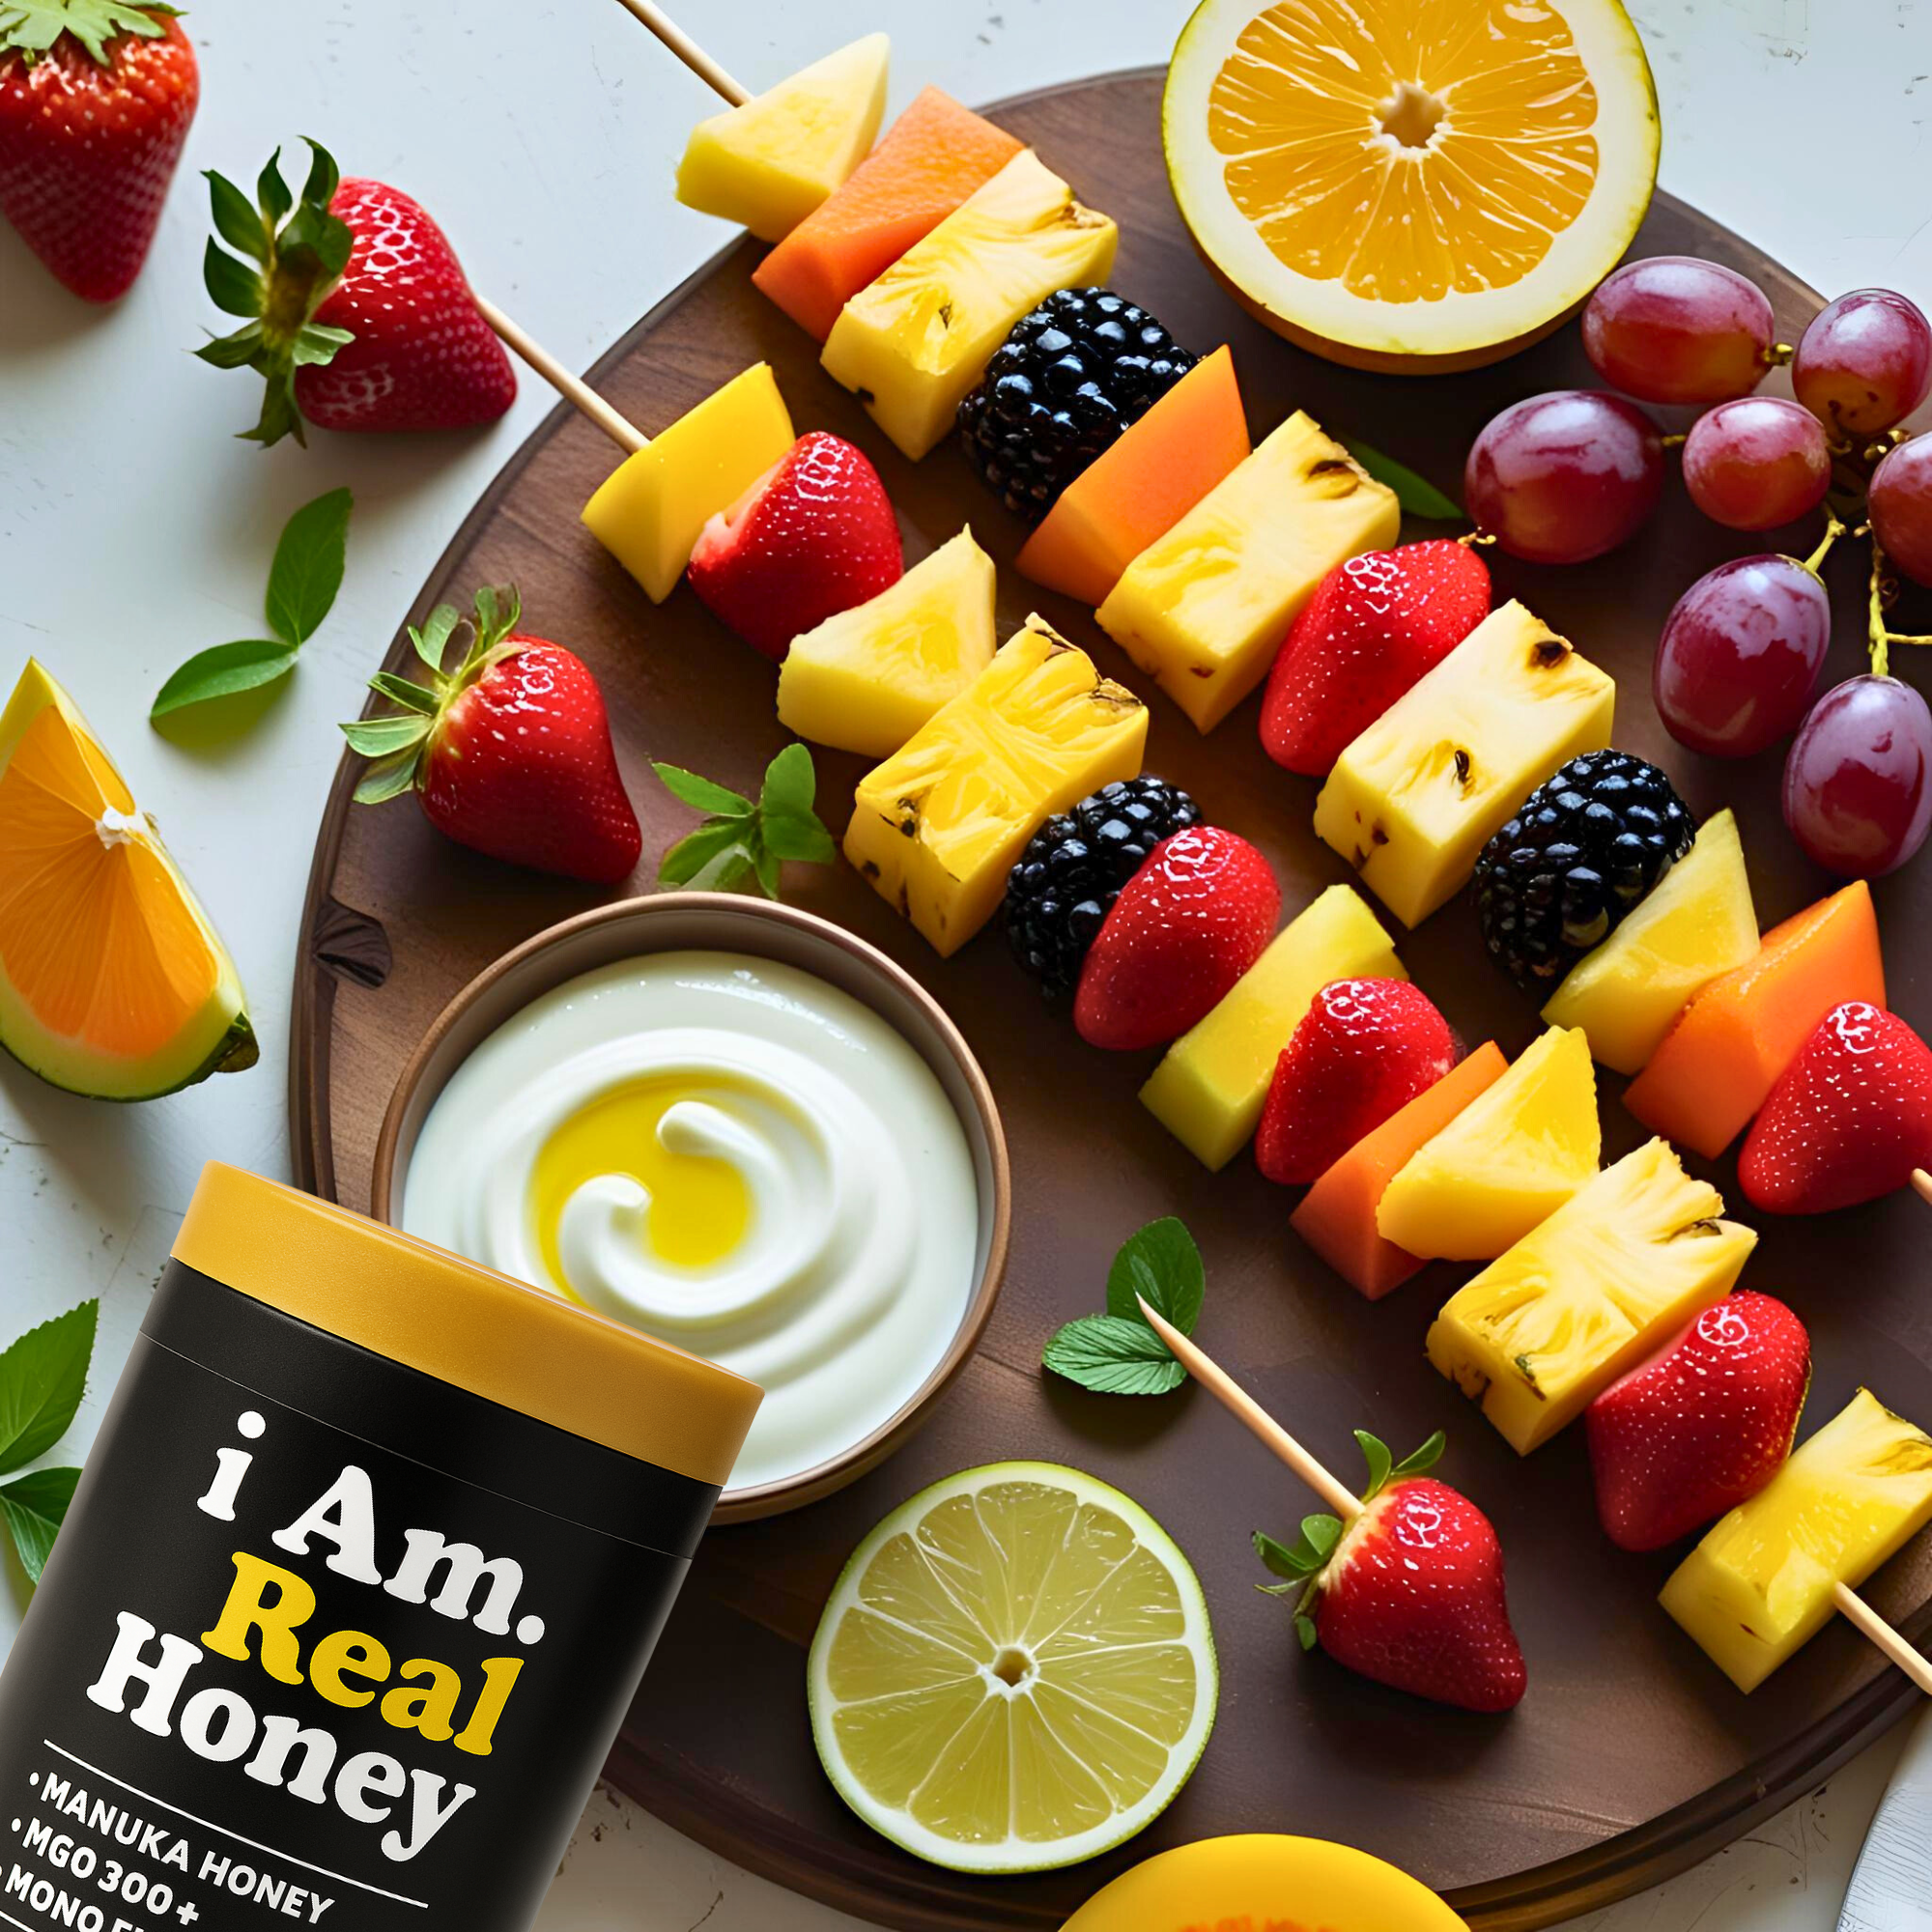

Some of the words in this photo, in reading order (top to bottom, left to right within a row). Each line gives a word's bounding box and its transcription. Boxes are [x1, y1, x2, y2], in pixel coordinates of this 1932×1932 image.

[197, 1410, 266, 1521] i
[271, 1464, 546, 1645] Am.
[87, 1610, 477, 1862] Honey
[201, 1551, 525, 1755] Real
[4, 1862, 104, 1932] MONO
[21, 1817, 98, 1879] MGO
[98, 1860, 200, 1926] 300+
[40, 1772, 189, 1873] MANUKA
[197, 1850, 336, 1924] HONEY
